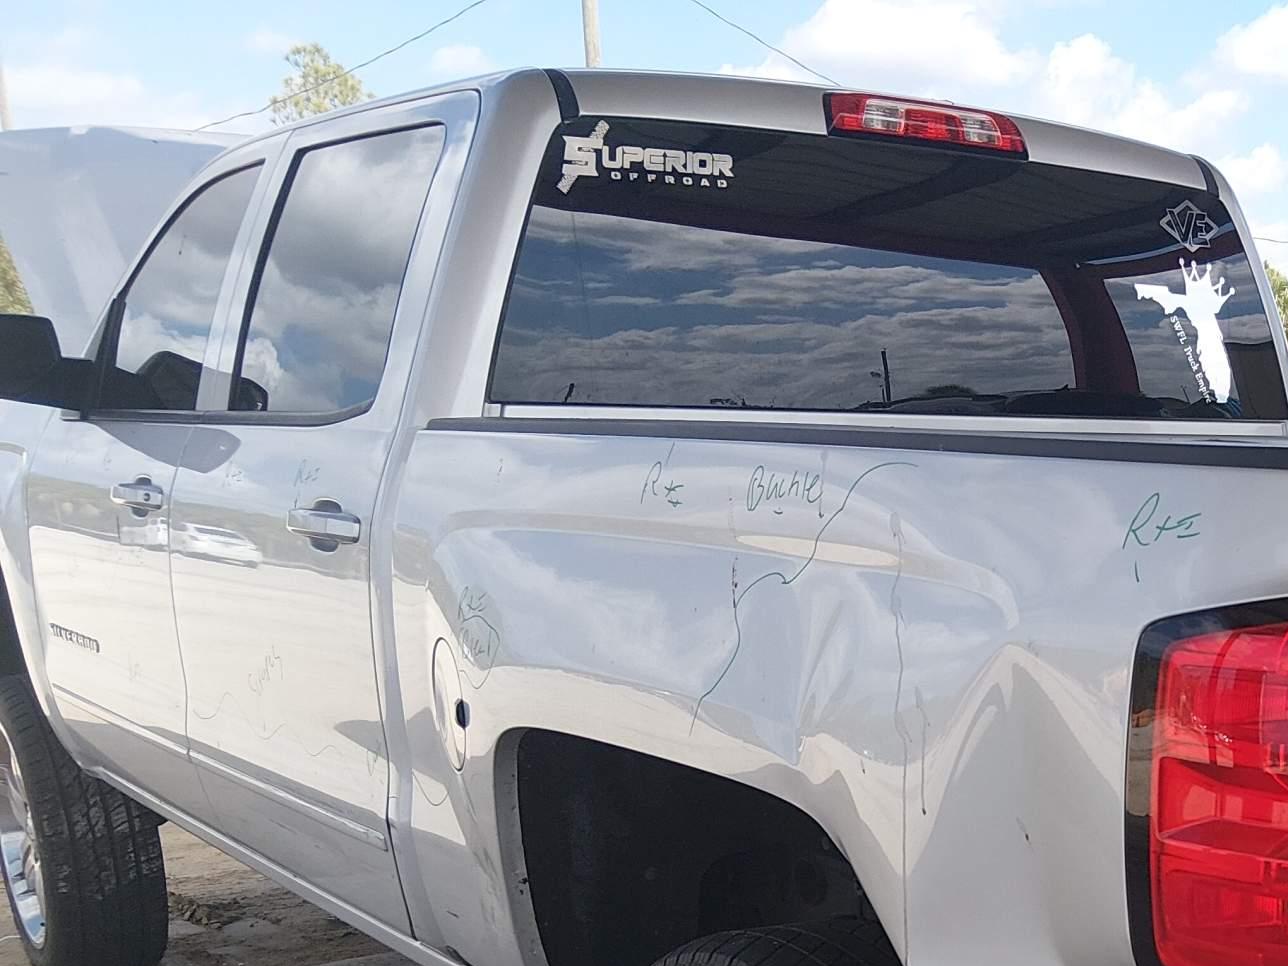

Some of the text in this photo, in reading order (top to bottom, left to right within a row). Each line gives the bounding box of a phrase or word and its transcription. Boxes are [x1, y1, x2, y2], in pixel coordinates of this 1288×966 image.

[556, 120, 735, 195] SUPERIOR
[610, 171, 729, 188] OFFROAD
[1167, 208, 1211, 248] VE
[1169, 315, 1212, 405] SWFL Truck Empire
